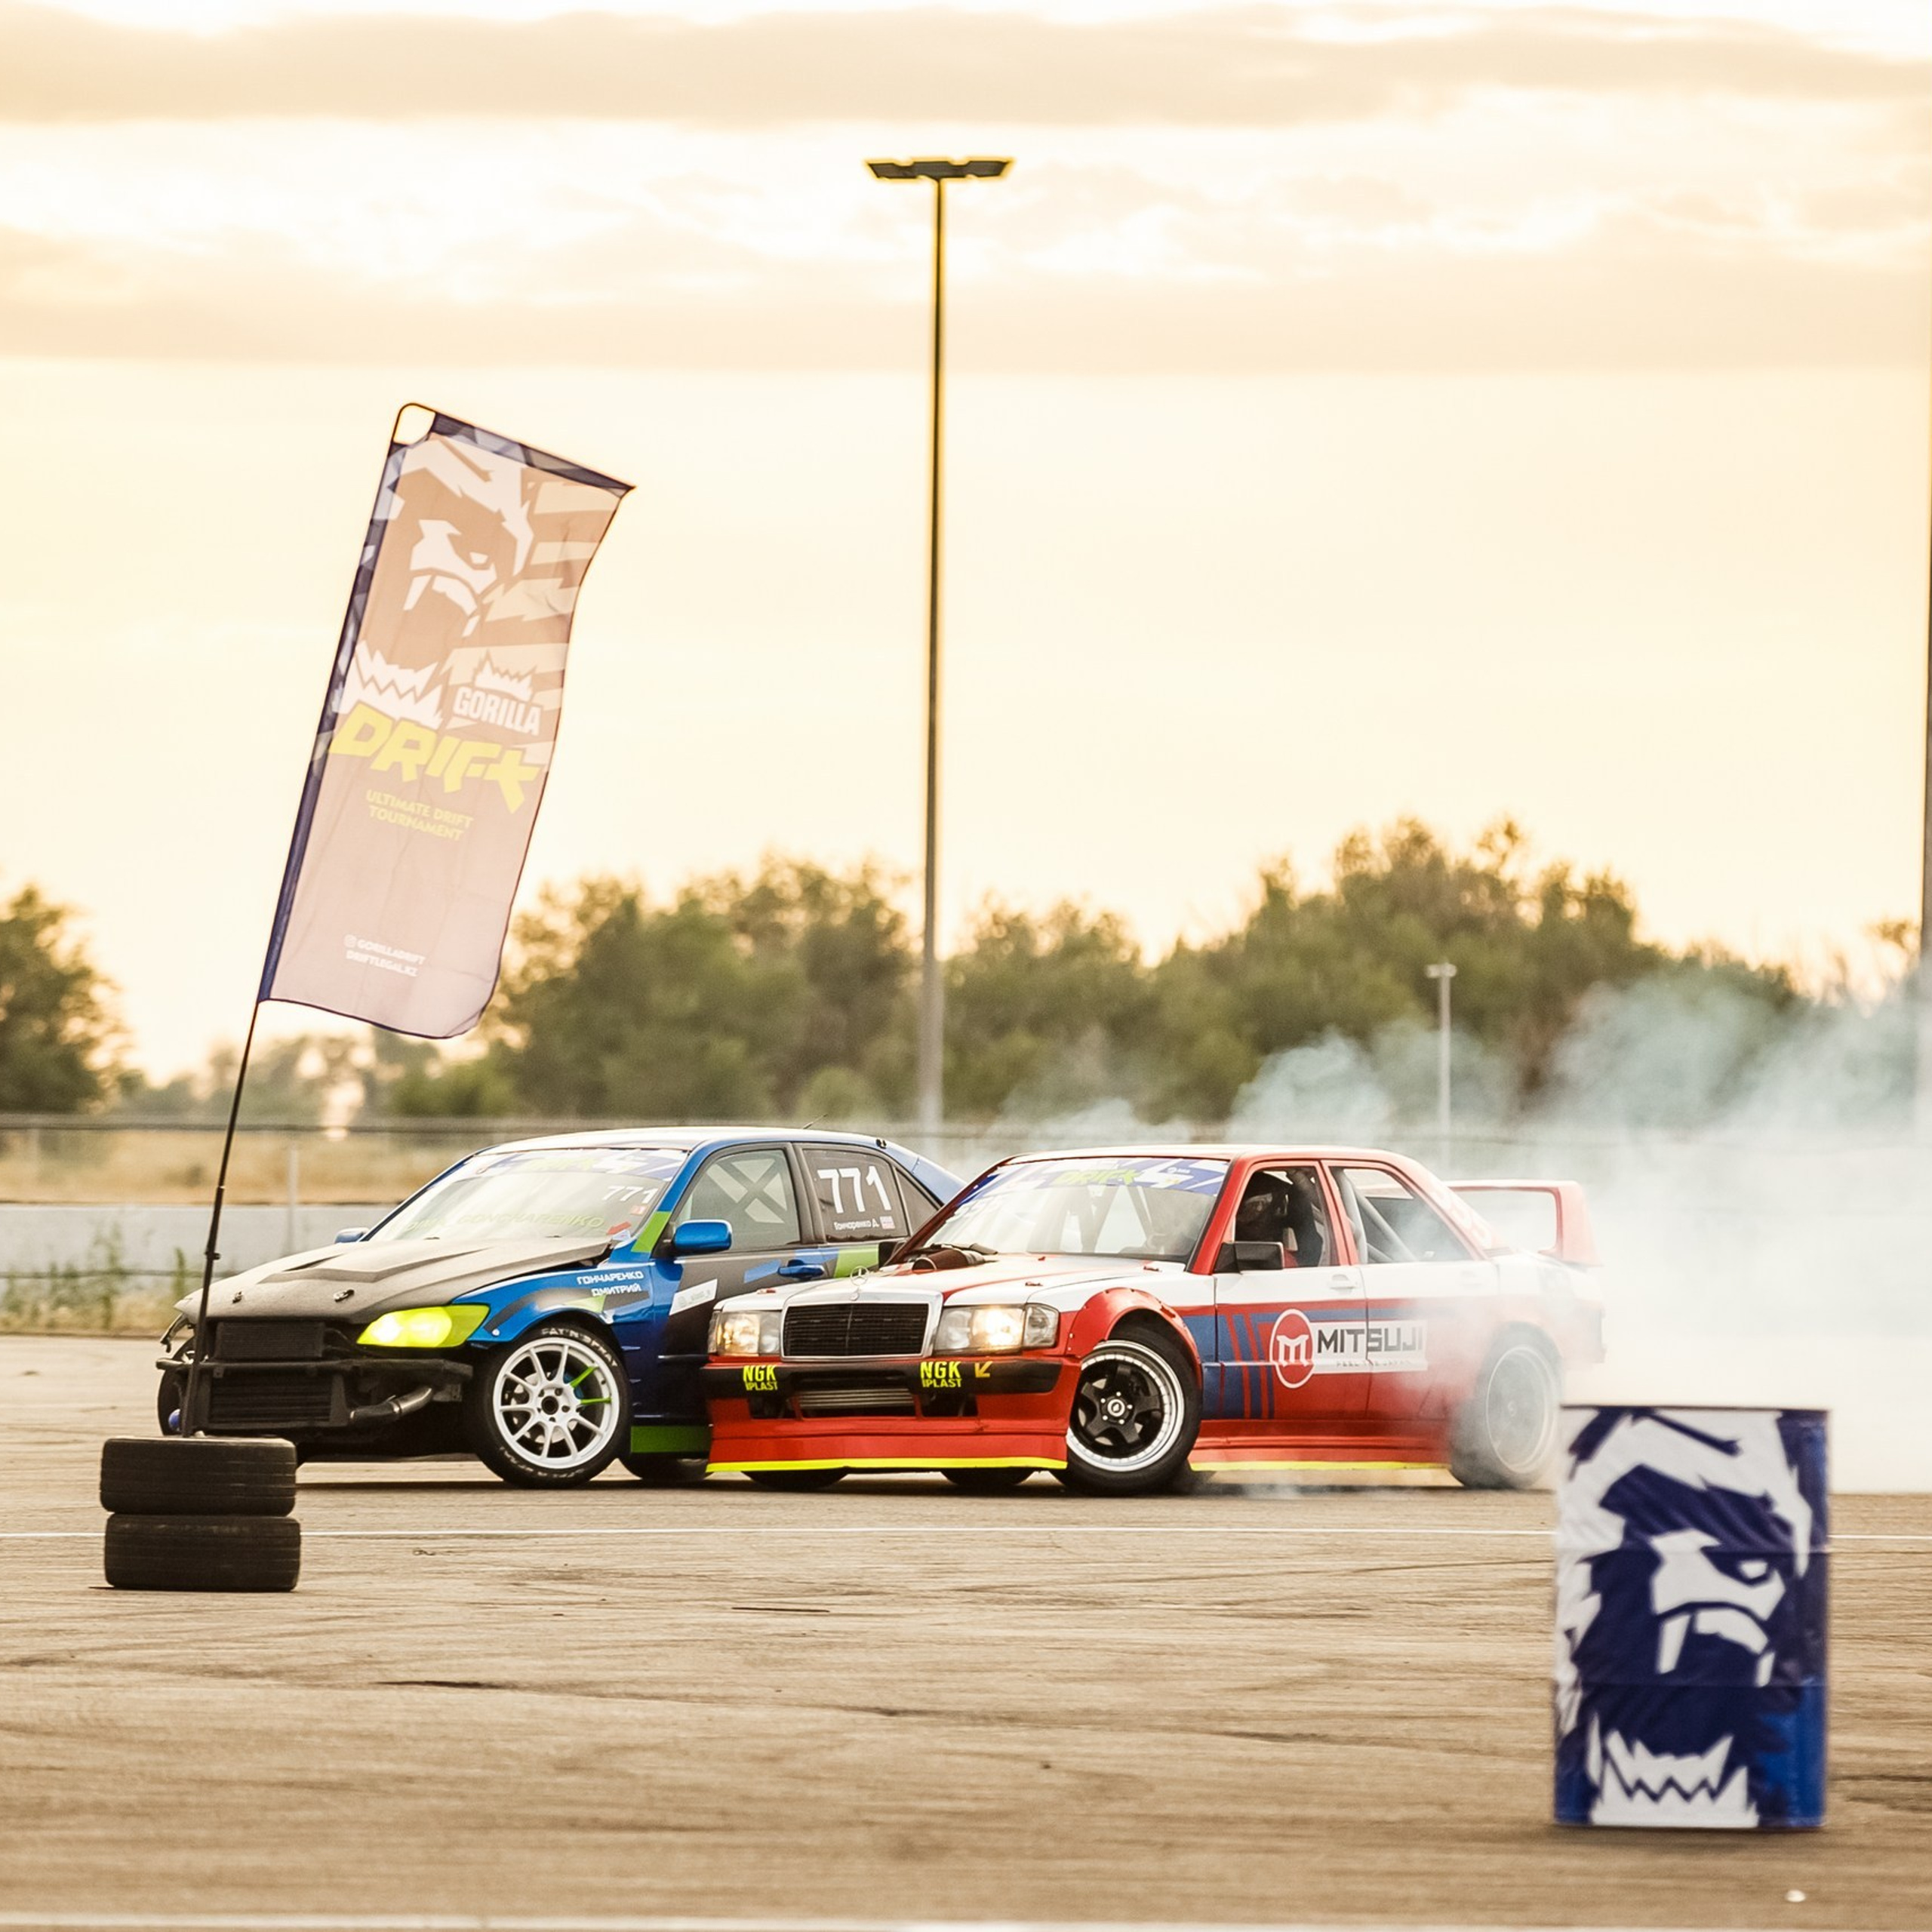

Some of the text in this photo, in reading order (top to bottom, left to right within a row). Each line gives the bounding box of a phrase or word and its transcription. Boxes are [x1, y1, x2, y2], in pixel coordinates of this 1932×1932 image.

[453, 686, 542, 737] GORILLA
[329, 702, 541, 814] DRIFT
[367, 789, 474, 829] ULTIMATE DRIFT
[369, 804, 463, 841] TOURNAMENT
[602, 1185, 659, 1204] 771
[817, 1165, 892, 1214] 771
[577, 1271, 644, 1284] ГОНЧАРЕНКО
[592, 1283, 641, 1297] ДМИТРИЙ
[1317, 1326, 1423, 1353] MITSUJI
[743, 1365, 777, 1382] NGK
[921, 1361, 961, 1379] NGK
